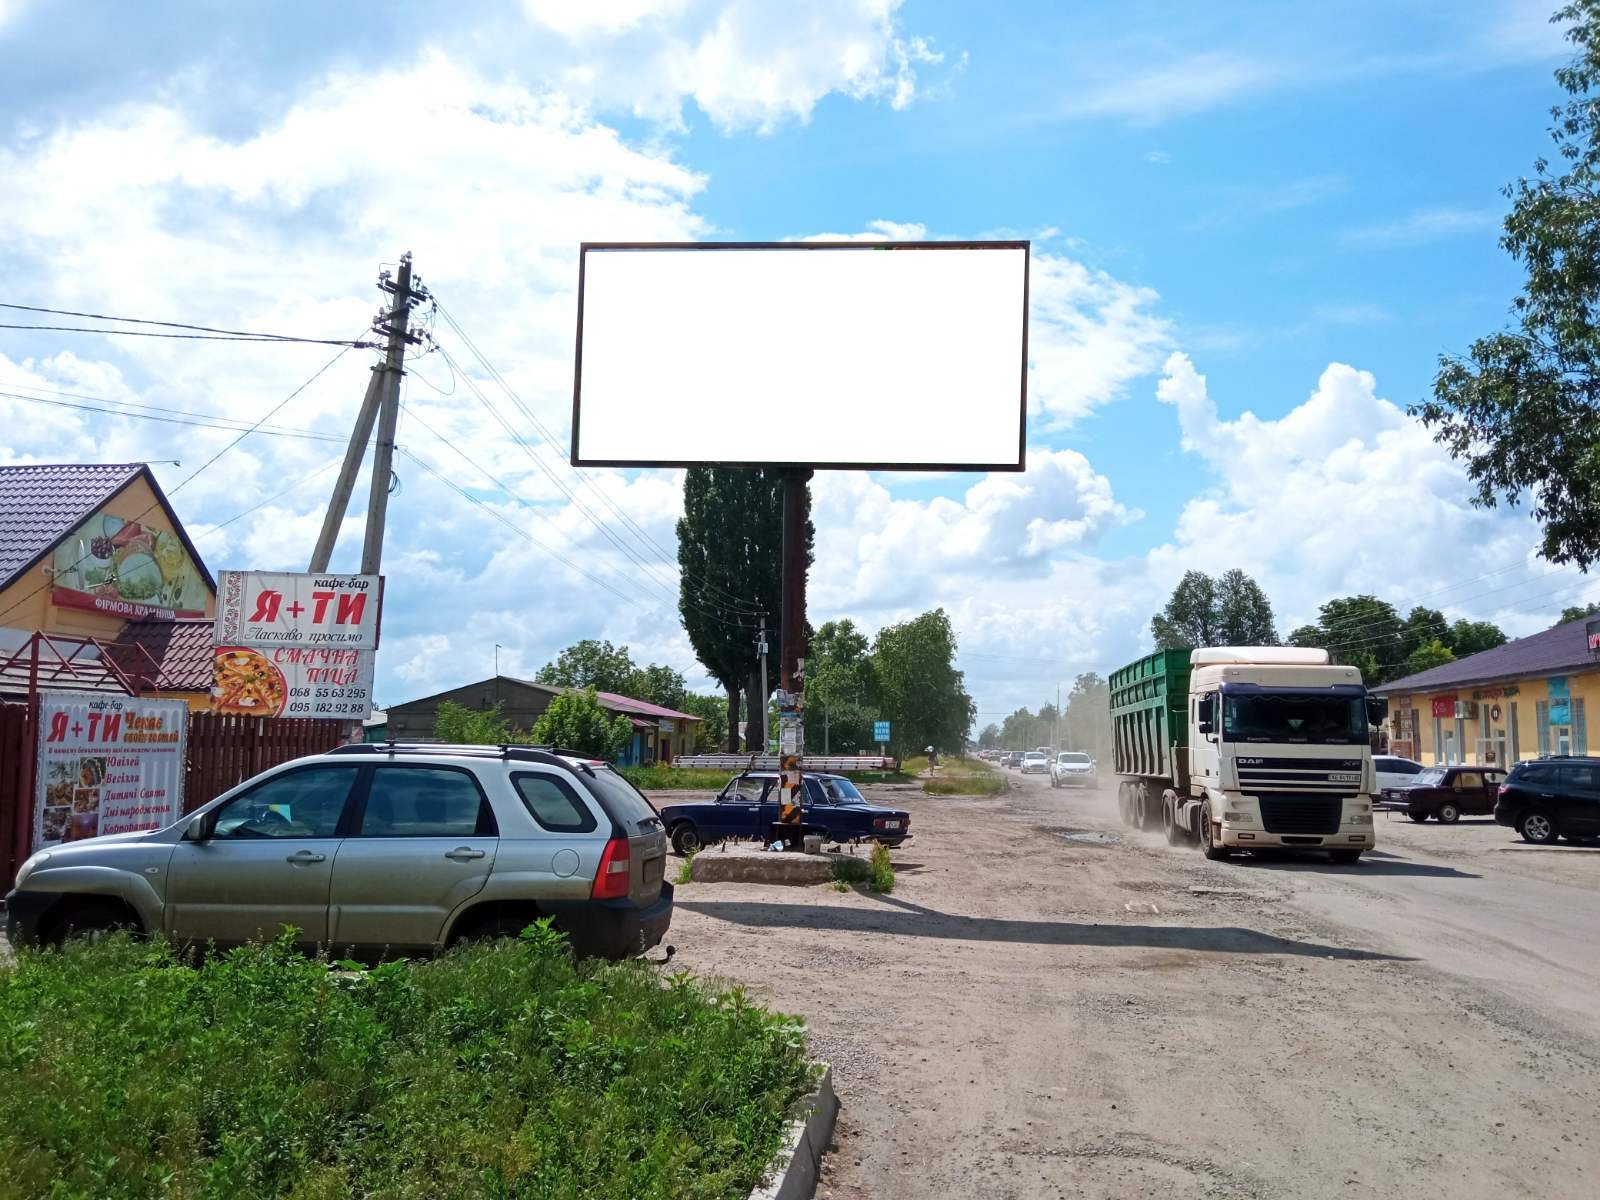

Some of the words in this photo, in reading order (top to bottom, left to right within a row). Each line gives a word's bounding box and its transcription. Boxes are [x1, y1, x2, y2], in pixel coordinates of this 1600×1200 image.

[314, 577, 369, 591] кафе-бар
[95, 598, 133, 615] ФІРМОВА
[245, 627, 303, 641] Ласкаво
[308, 632, 363, 643] просимо
[274, 647, 359, 665] СМАЧНА
[306, 668, 358, 686] ПІЦА
[290, 688, 310, 698] 068
[315, 689, 328, 698] 55
[346, 689, 366, 699] 295
[88, 701, 124, 713] кафе-бар
[290, 702, 310, 712] 095
[315, 703, 332, 713] 182
[335, 704, 348, 713] 92
[350, 704, 364, 713] 88
